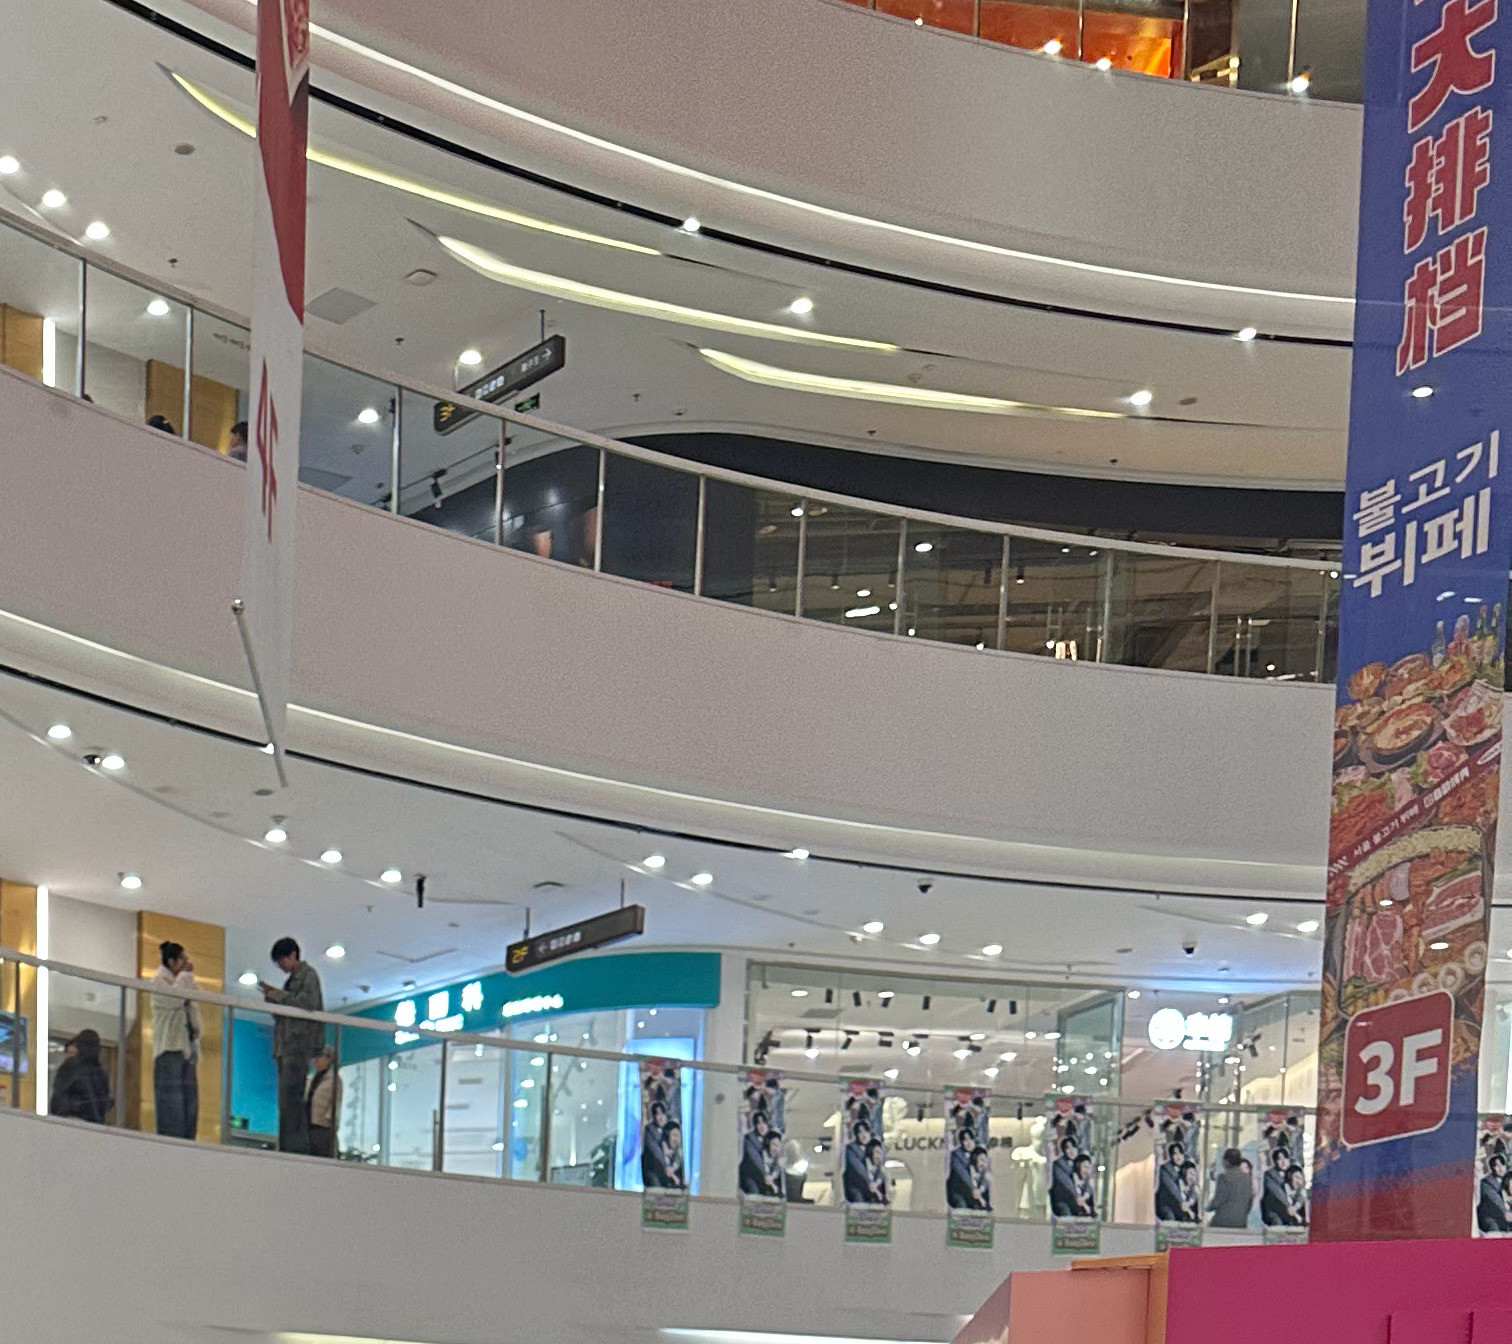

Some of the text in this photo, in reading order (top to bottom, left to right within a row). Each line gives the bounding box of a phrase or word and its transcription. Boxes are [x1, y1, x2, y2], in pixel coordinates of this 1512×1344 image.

[1397, 0, 1497, 377] 大排档
[1352, 429, 1500, 538] 불고기
[1352, 486, 1491, 599] 뷔페
[1353, 1028, 1444, 1116] 3F
